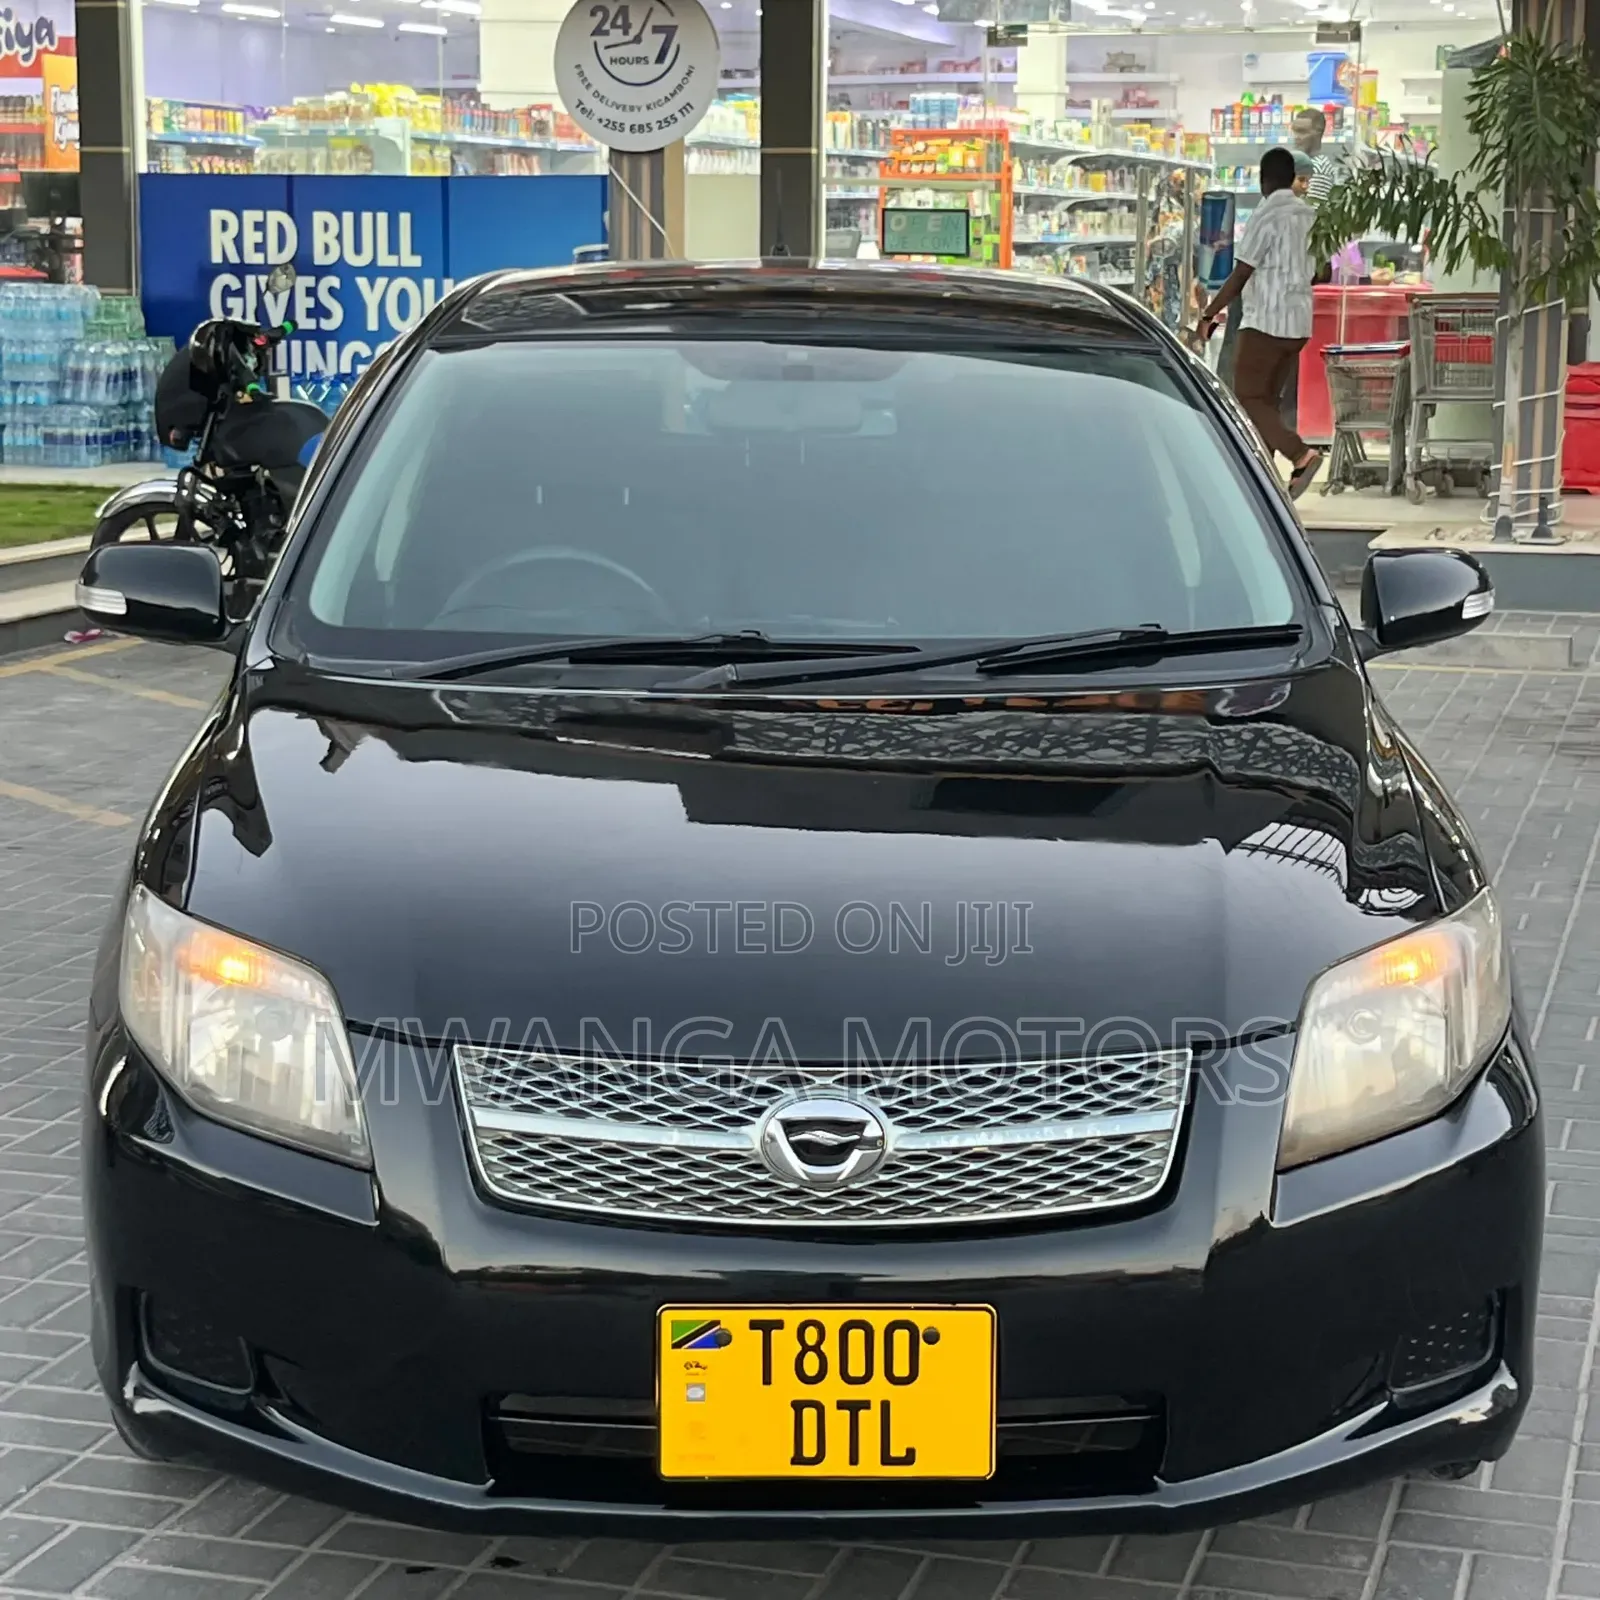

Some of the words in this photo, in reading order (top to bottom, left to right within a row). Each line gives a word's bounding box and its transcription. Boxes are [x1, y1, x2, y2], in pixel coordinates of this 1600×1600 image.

[0, 7, 55, 63] iya
[609, 56, 650, 66] HOURS
[573, 63, 591, 92] FREE
[591, 89, 643, 113] DELIVERY
[596, 117, 626, 134] +255
[629, 122, 654, 135] 685
[656, 113, 679, 131] 255
[209, 208, 299, 266] RED
[311, 210, 423, 268] BULL
[208, 272, 344, 332] GIVES
[748, 1318, 921, 1387] T800
[790, 1398, 917, 1467] DTL
